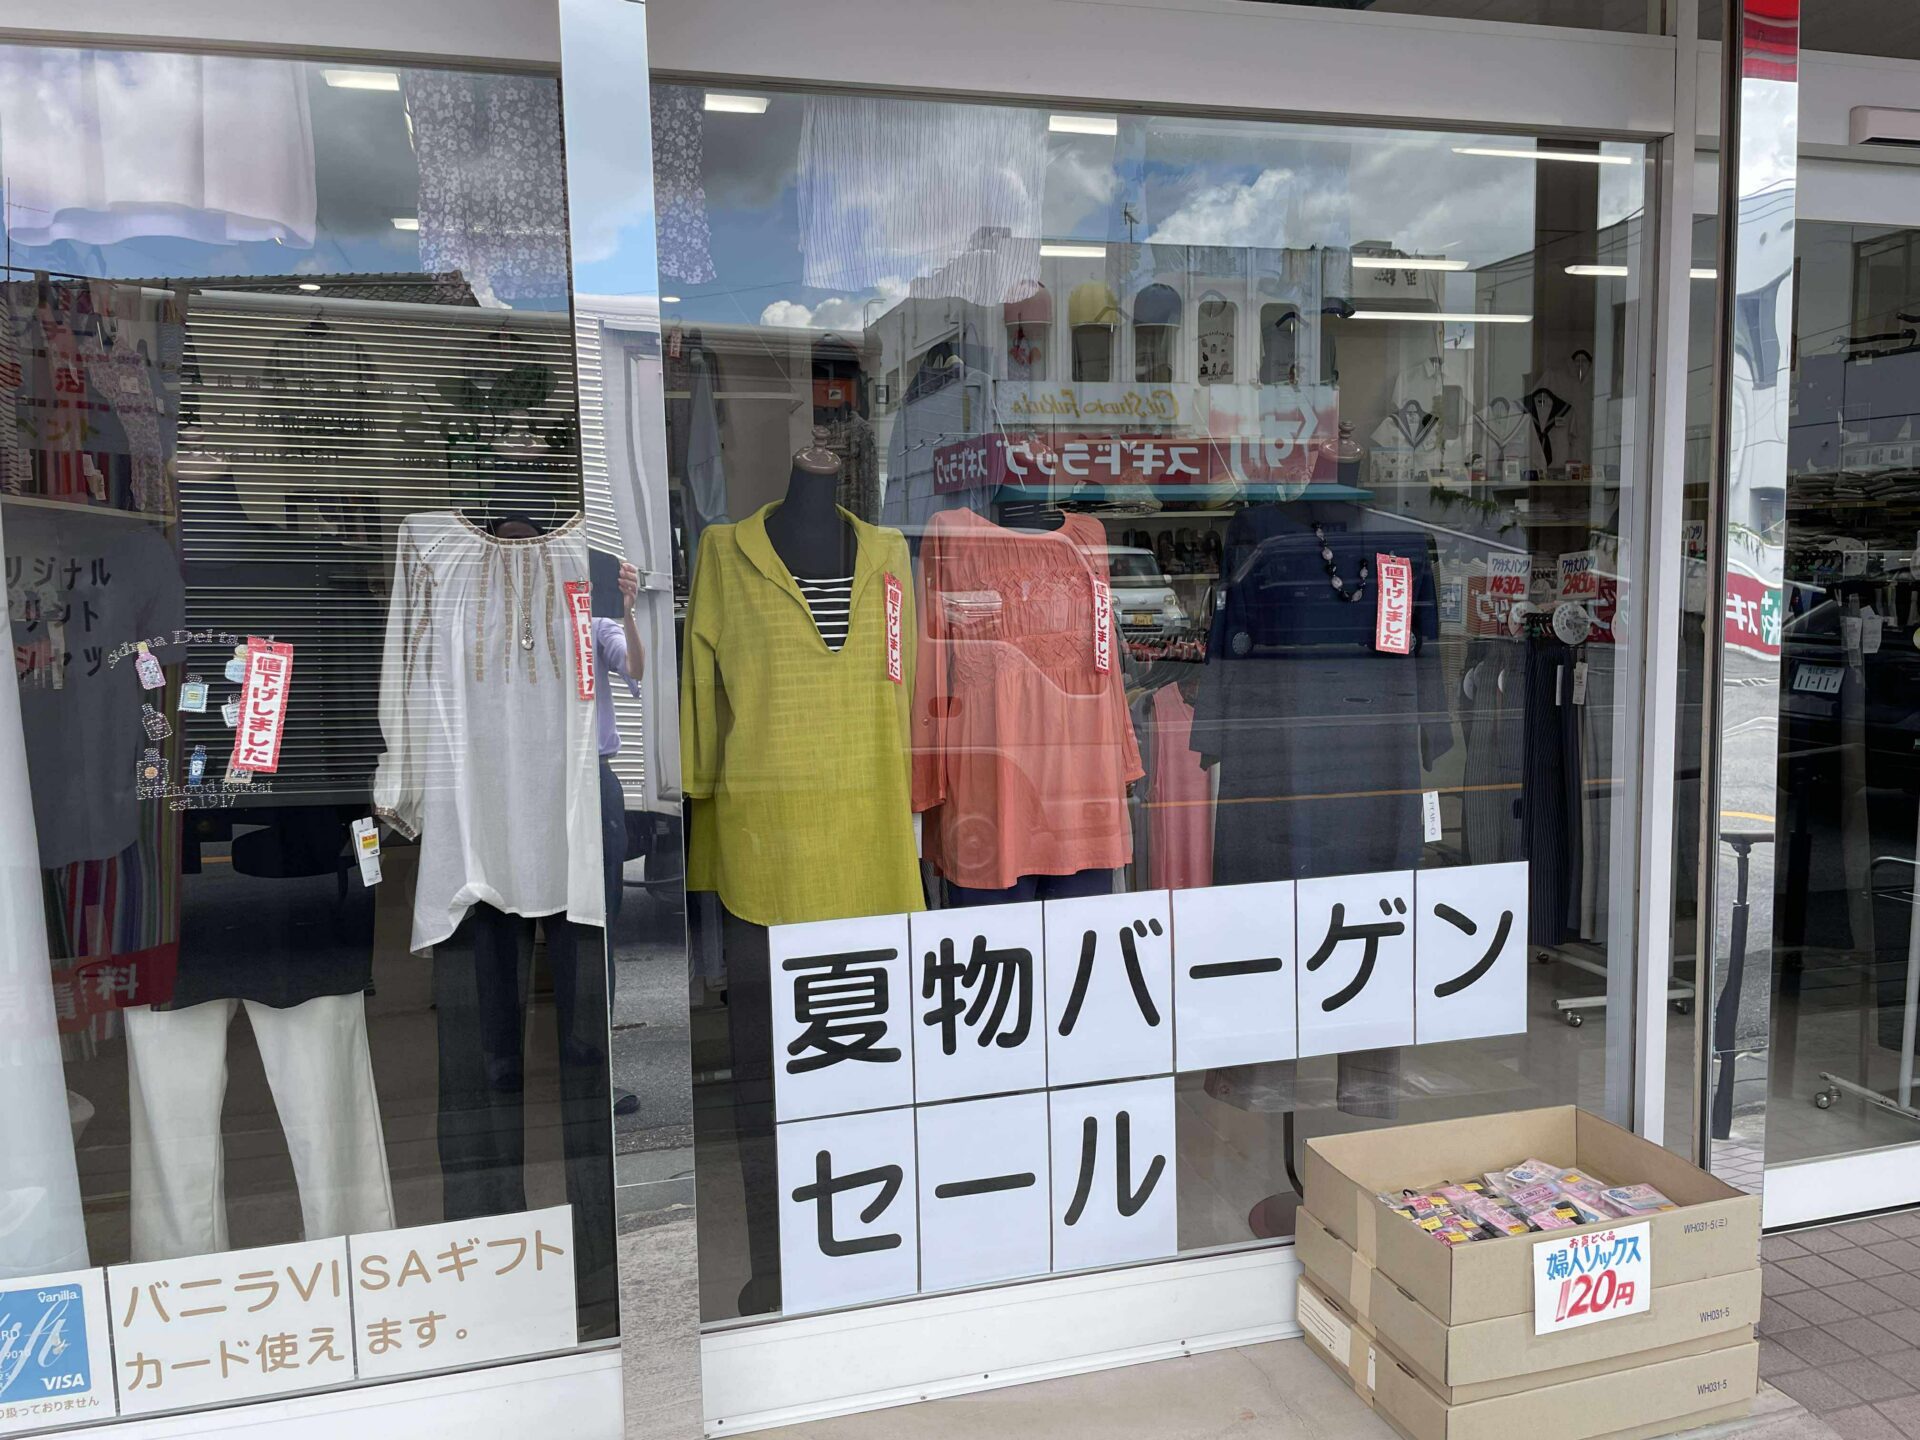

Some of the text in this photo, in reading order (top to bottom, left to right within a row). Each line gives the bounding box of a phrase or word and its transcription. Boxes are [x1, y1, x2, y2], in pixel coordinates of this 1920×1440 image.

[1384, 565, 1404, 647] 値下げしました
[243, 655, 283, 764] 値下げしました
[782, 897, 1514, 1075] 夏物バーゲン
[790, 1109, 1167, 1258] セール
[122, 1230, 565, 1329] バニラVISAギフト
[1546, 1236, 1642, 1280] 婦人ソックス
[37, 1289, 80, 1304] Vanilla
[1555, 1269, 1635, 1322] 120円
[1700, 1307, 1730, 1324] WH031-5
[40, 1373, 85, 1391] VISA
[125, 1310, 470, 1393] カード使えます。
[1697, 1379, 1728, 1396] WH031-5
